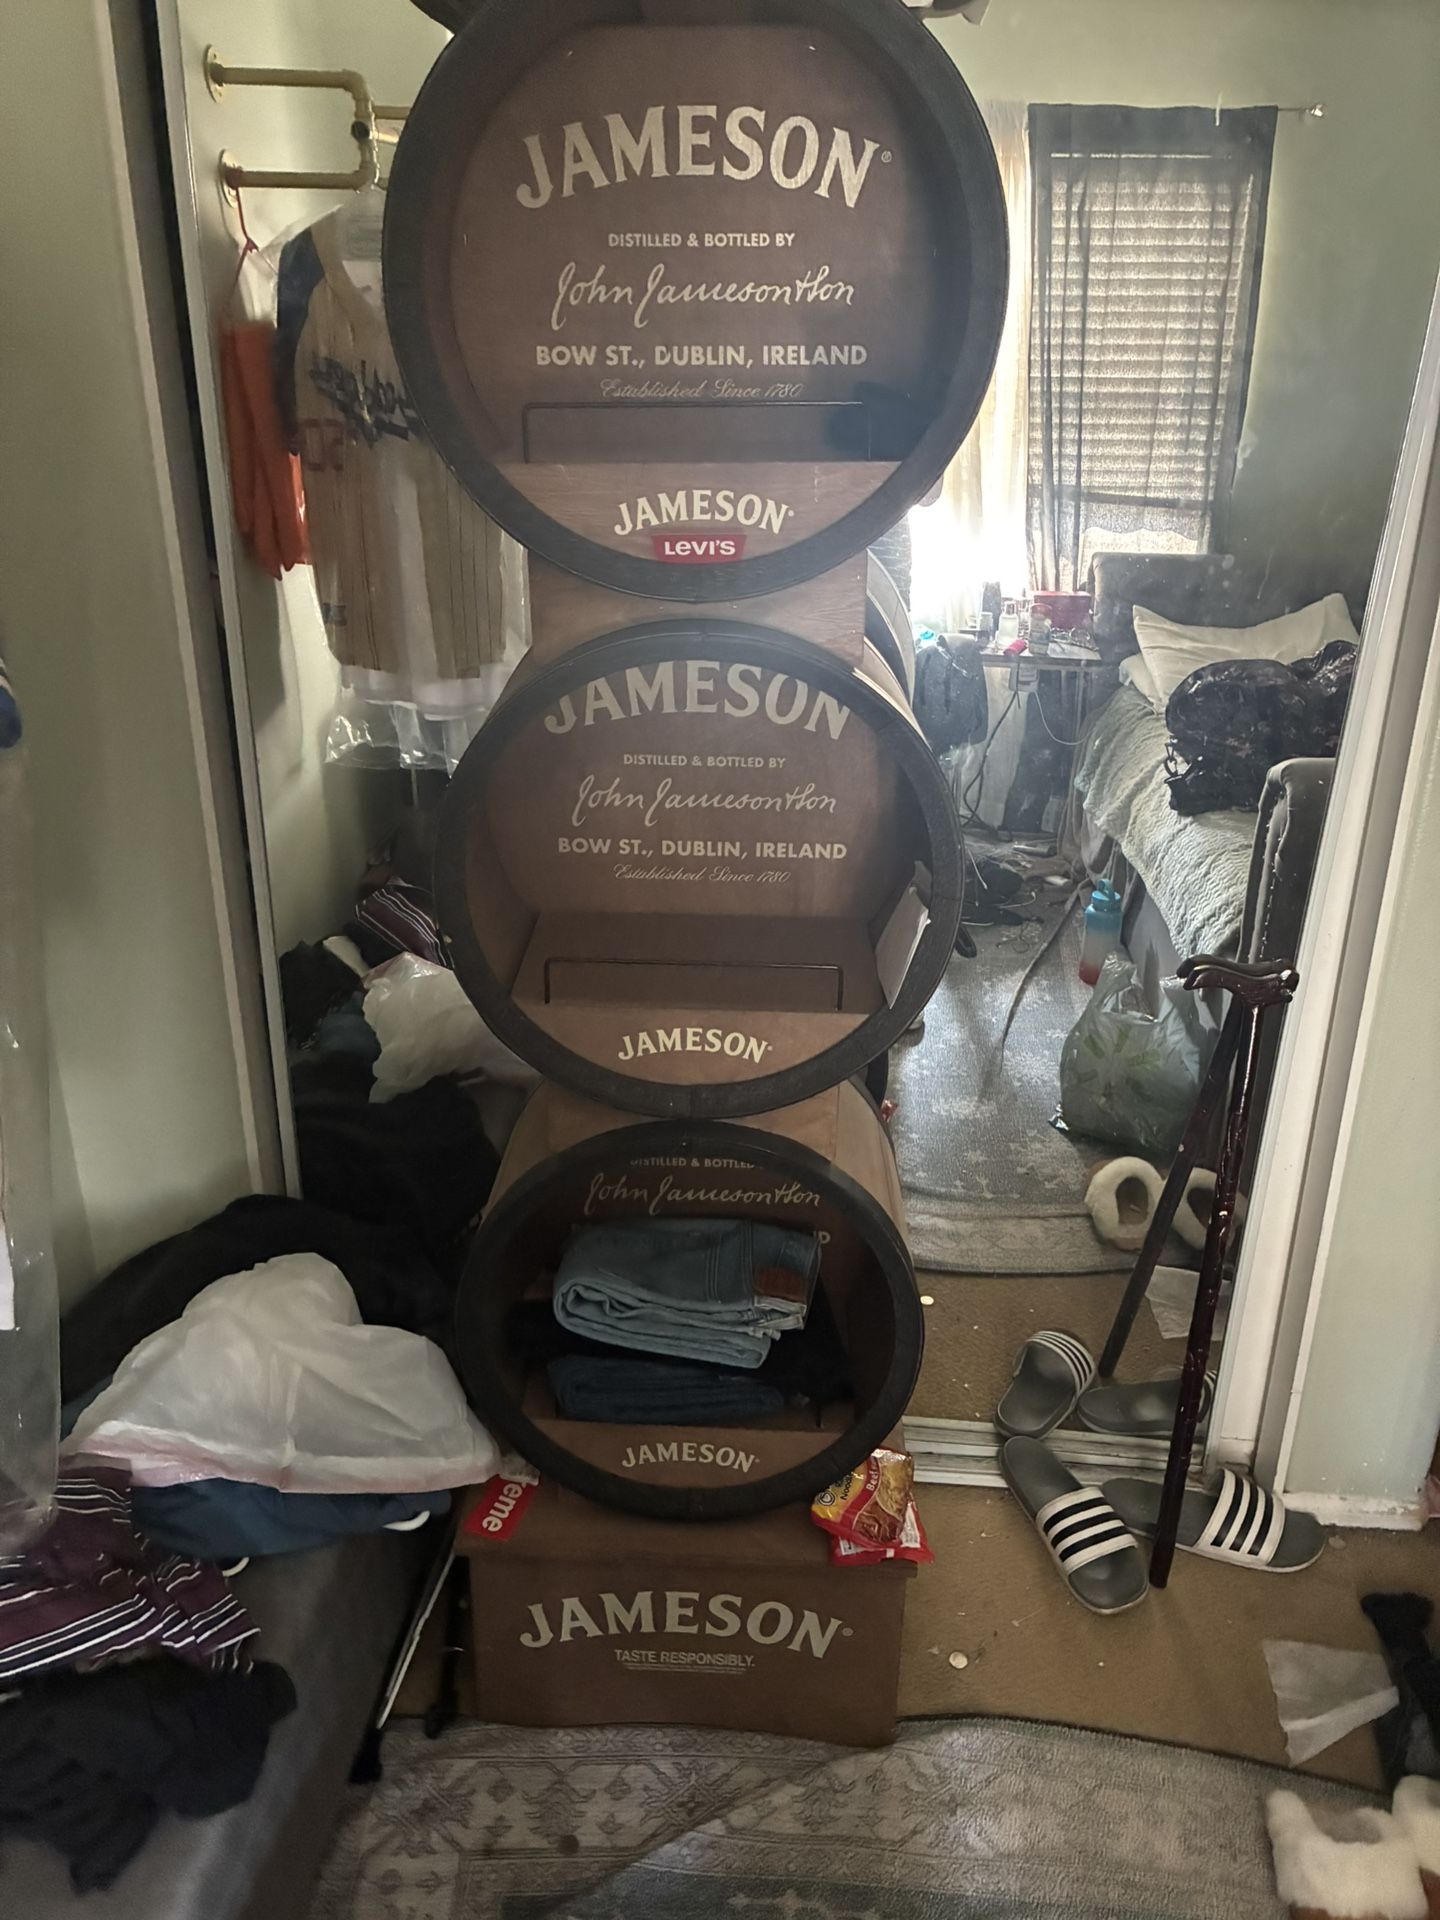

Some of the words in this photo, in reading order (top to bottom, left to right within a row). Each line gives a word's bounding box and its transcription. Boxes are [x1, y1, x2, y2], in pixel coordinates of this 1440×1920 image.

[608, 232, 682, 248] DISTILLED
[687, 232, 699, 247] &
[704, 232, 770, 248] BOTTLED
[775, 233, 795, 248] BY
[551, 261, 632, 331] John
[633, 262, 791, 328] Jameson
[536, 345, 597, 366] BOW
[605, 345, 645, 369] ST.,
[655, 345, 753, 369] DUBLIN,
[763, 345, 868, 366] IRELAND
[600, 379, 708, 399] Established
[712, 379, 761, 399] Since
[544, 659, 851, 740] JAMESON
[623, 754, 687, 767] DISTILLED
[692, 754, 702, 767] &
[707, 755, 764, 768] BOTTLED
[769, 756, 786, 769] BY
[572, 774, 643, 827] John
[645, 777, 780, 827] Jameson
[558, 837, 611, 854] BOW
[619, 839, 653, 857] ST.,
[661, 840, 748, 860] DUBLIN,
[755, 842, 848, 860] IRELAND
[613, 863, 704, 882] Established
[708, 866, 753, 883] Since
[756, 868, 792, 884] 1780
[691, 1158, 700, 1168] &
[584, 1173, 648, 1216] John
[614, 1649, 657, 1663] TASTE
[660, 1651, 755, 1667] RESPONSIBLY.
